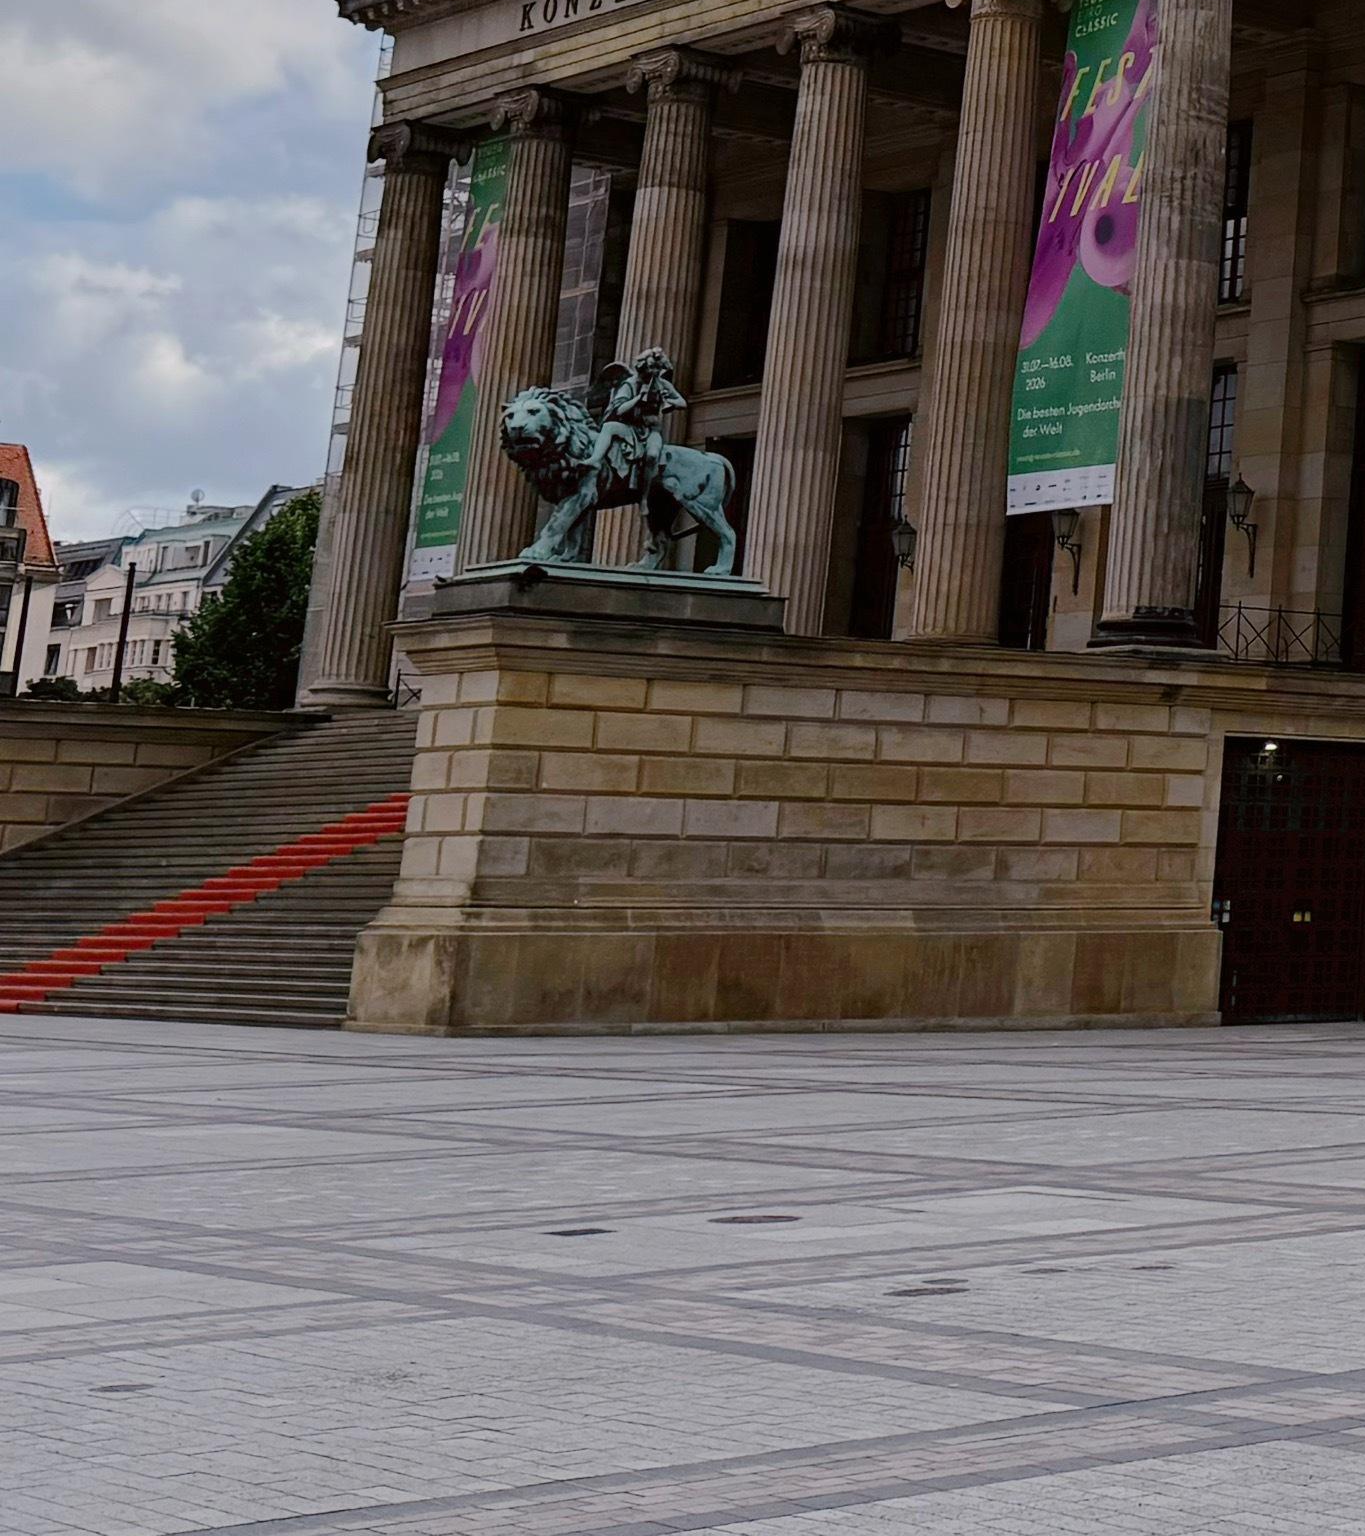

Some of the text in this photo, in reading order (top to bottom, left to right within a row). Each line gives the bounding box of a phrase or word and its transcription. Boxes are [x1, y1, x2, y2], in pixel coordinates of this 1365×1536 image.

[1075, 12, 1119, 38] CLASSIC
[1060, 44, 1162, 122] FEST
[1049, 151, 1145, 224] IVAL
[1090, 368, 1116, 382] Berlin
[1017, 408, 1031, 420] Die
[1033, 406, 1065, 419] besten
[1023, 422, 1062, 438] der Welt
